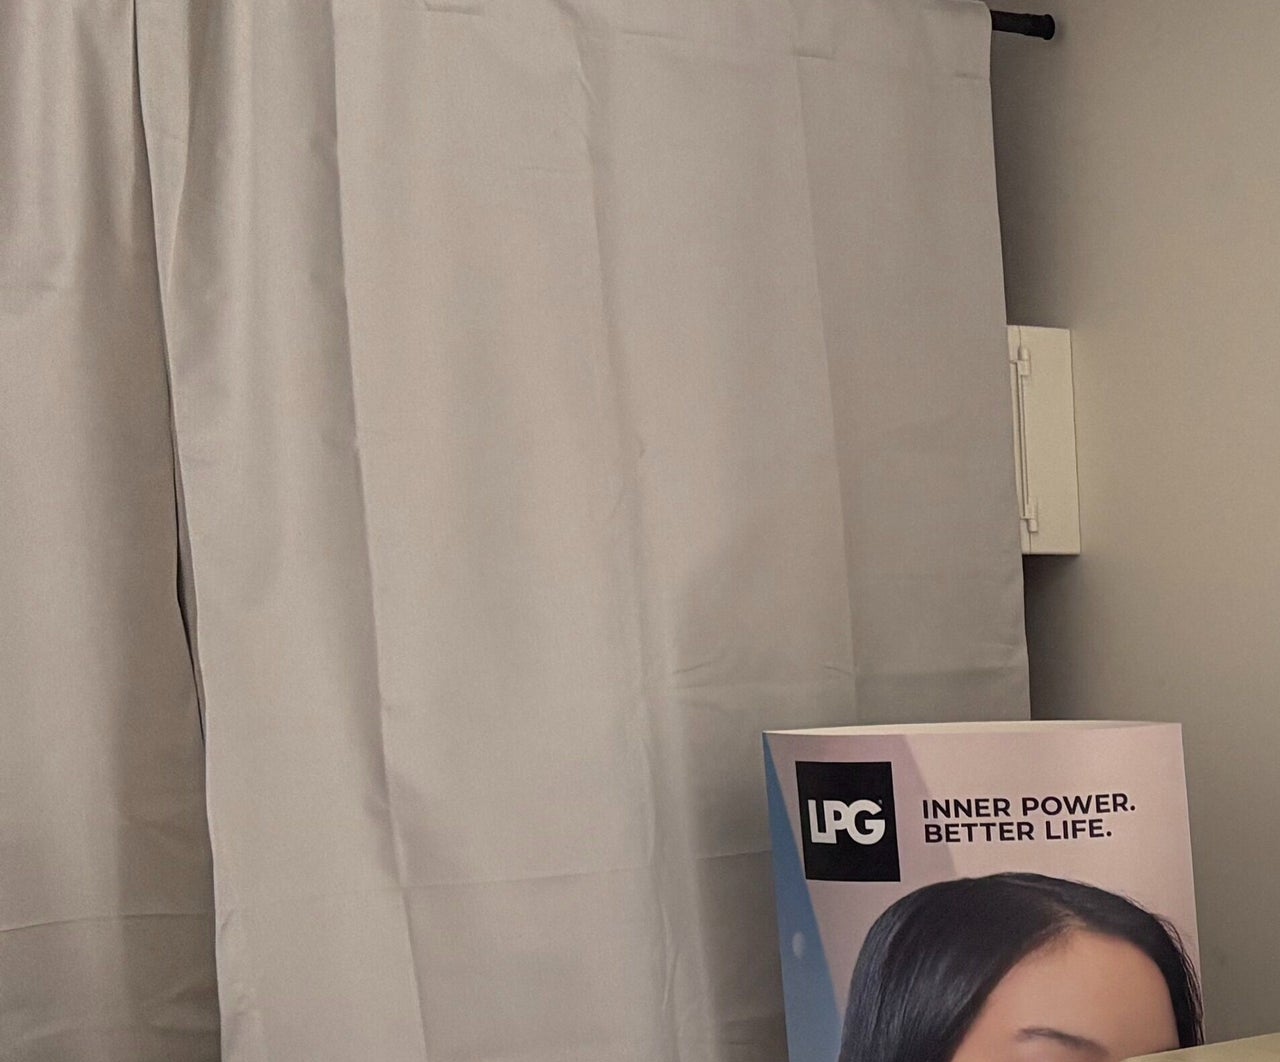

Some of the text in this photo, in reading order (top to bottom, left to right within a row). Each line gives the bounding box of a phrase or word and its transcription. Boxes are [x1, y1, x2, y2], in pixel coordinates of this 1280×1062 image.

[922, 793, 1136, 819] INNER POWER.
[808, 798, 886, 845] LPG
[924, 819, 1112, 844] BETTER LIFE.
